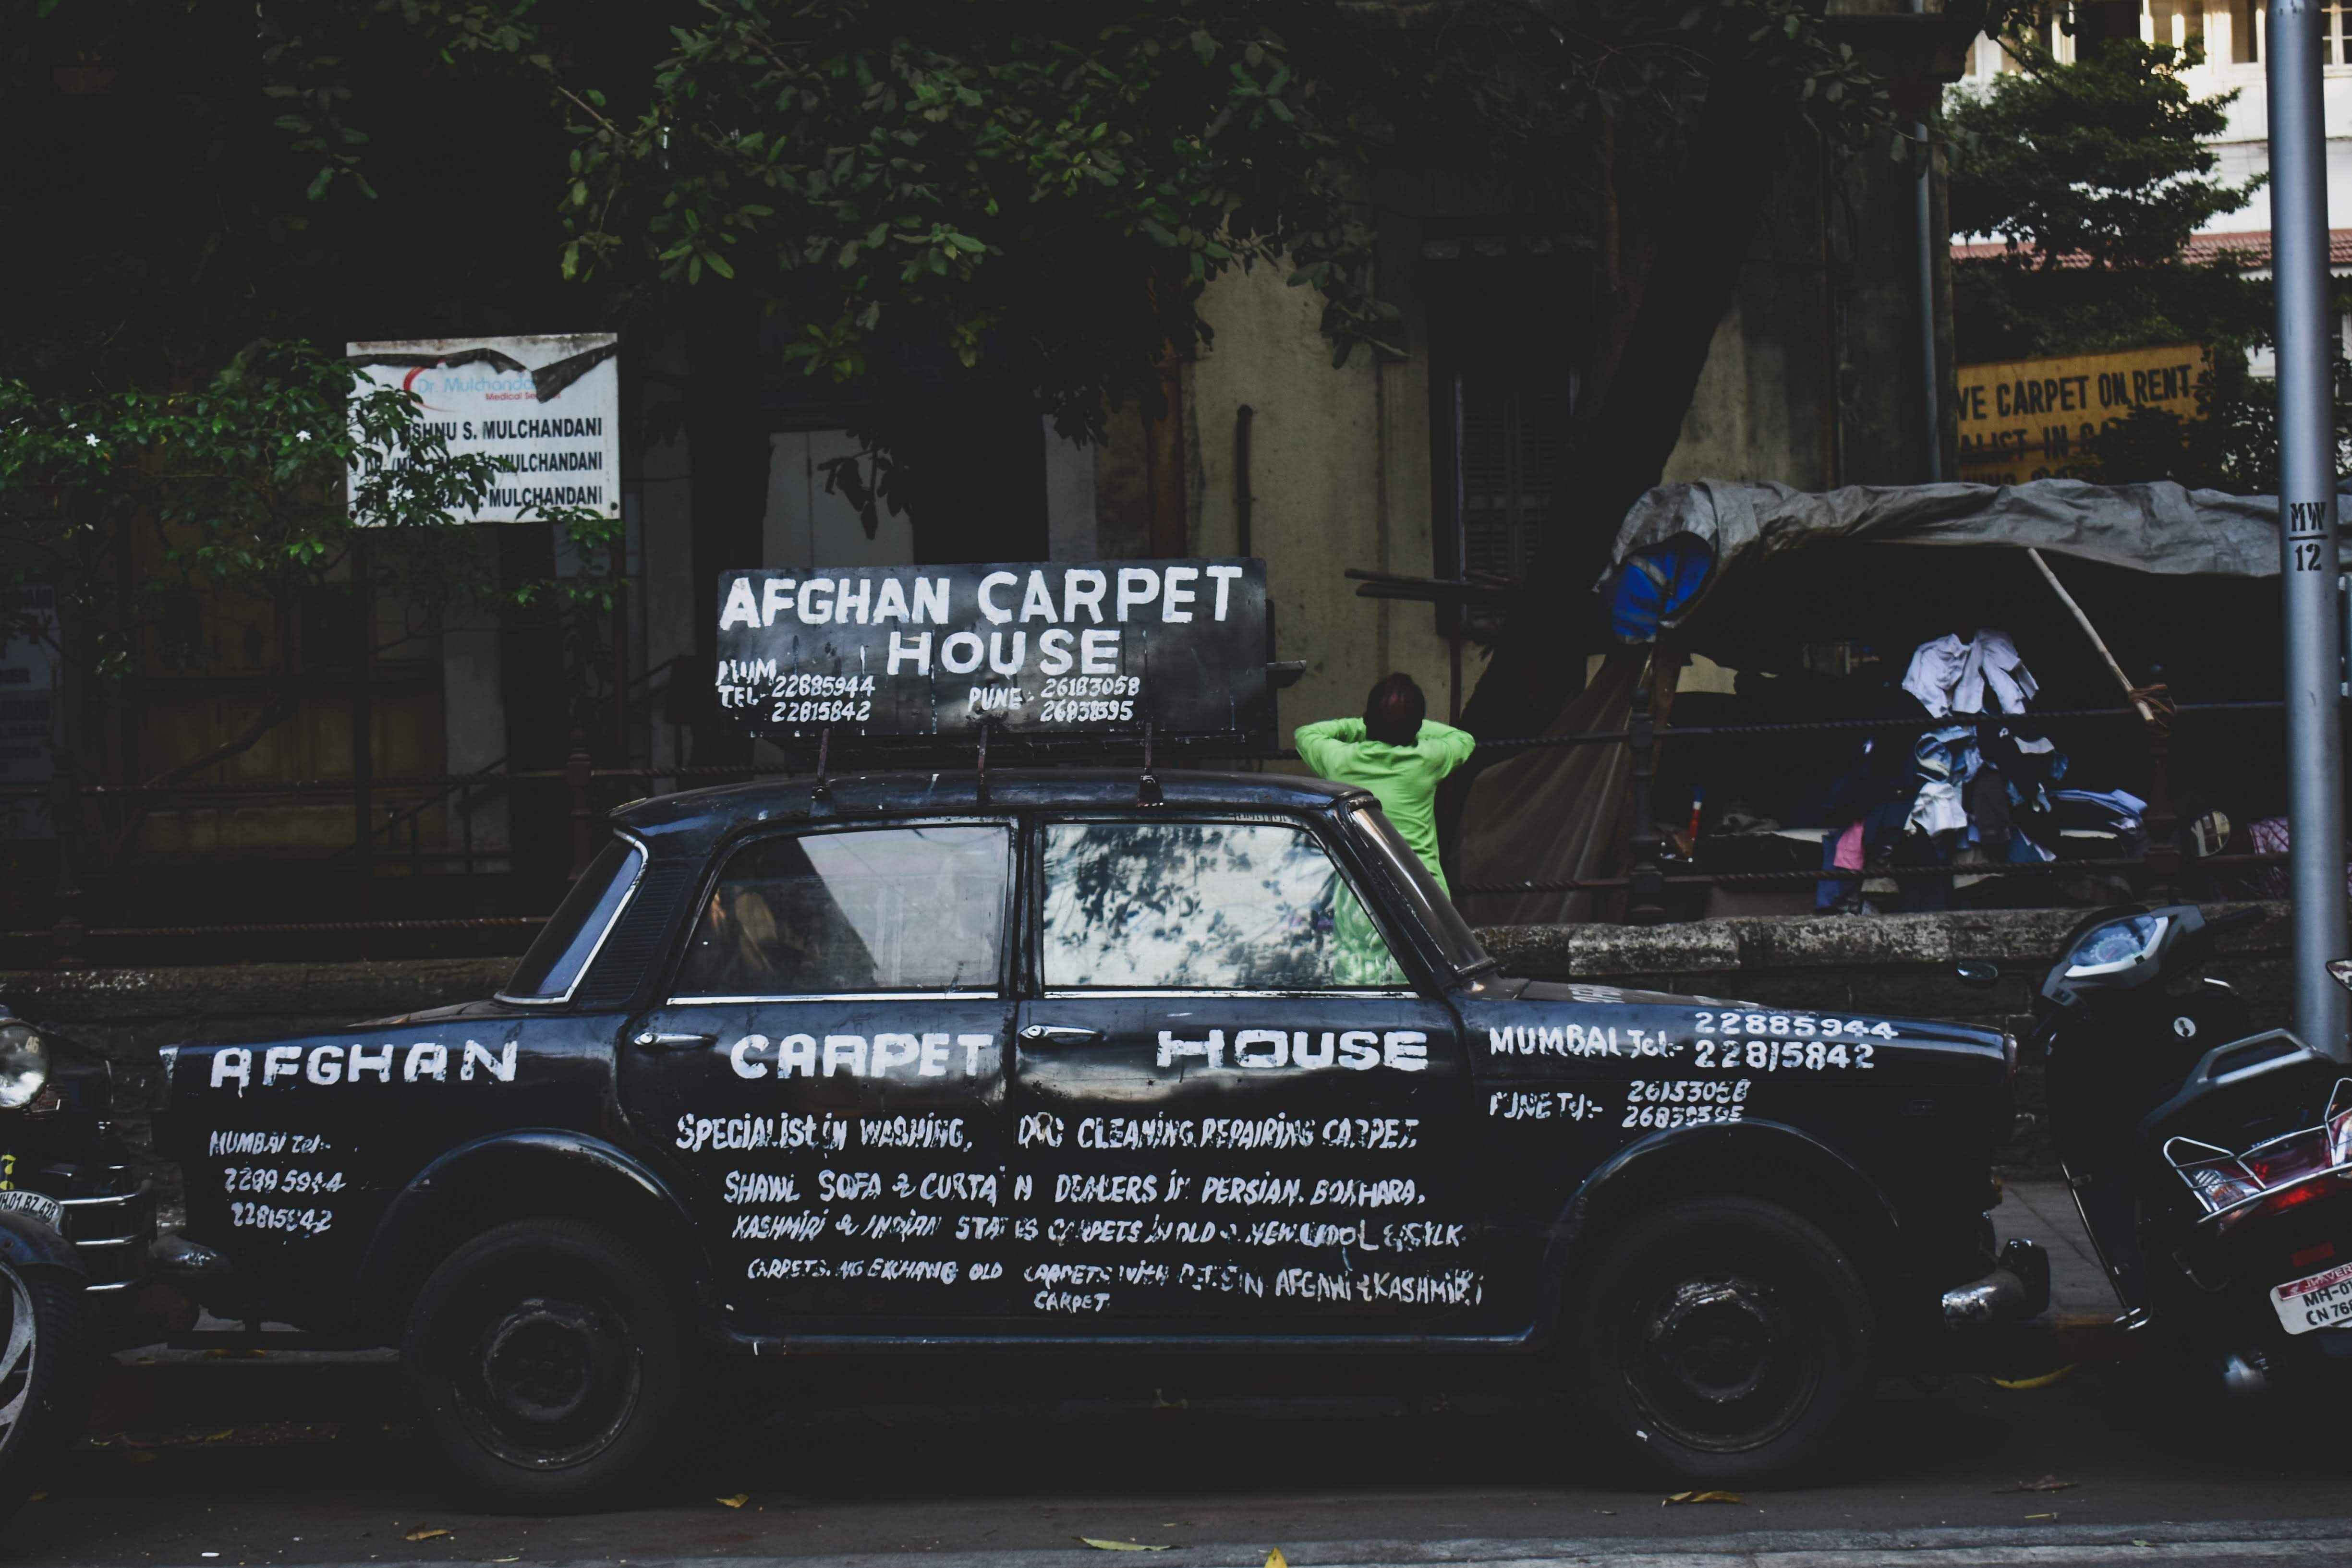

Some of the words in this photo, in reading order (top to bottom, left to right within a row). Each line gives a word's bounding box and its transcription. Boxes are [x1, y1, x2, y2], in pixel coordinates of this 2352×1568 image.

[485, 392, 522, 401] Medical
[1996, 375, 2089, 417] CARPET
[2099, 372, 2127, 408] ON
[2133, 364, 2192, 402] RENT
[463, 421, 477, 440] S.
[482, 417, 602, 440] MULCHANDANI
[489, 485, 602, 507] MULCHANDANI
[2290, 502, 2326, 531] MW
[2295, 543, 2322, 571] 12
[719, 576, 950, 630] AFGHAN
[977, 565, 1243, 626] CARPET
[887, 628, 1121, 679] HOUSE
[772, 674, 876, 698] 22885944
[772, 700, 872, 722] 22815842
[1489, 1023, 1622, 1057] MUMBAI
[1695, 1012, 1899, 1040] 22885944
[210, 1039, 517, 1090] AFGHAN
[730, 1033, 994, 1079] CARPET
[1157, 1029, 1428, 1071] HOUSE
[1695, 1039, 1874, 1072] 22815842
[818, 1170, 881, 1202] SOFA
[1055, 1174, 1157, 1204] DEALERS
[969, 1262, 1003, 1281] OLD
[1033, 1290, 1110, 1314] CARPET
[2306, 1307, 2329, 1326] CN
